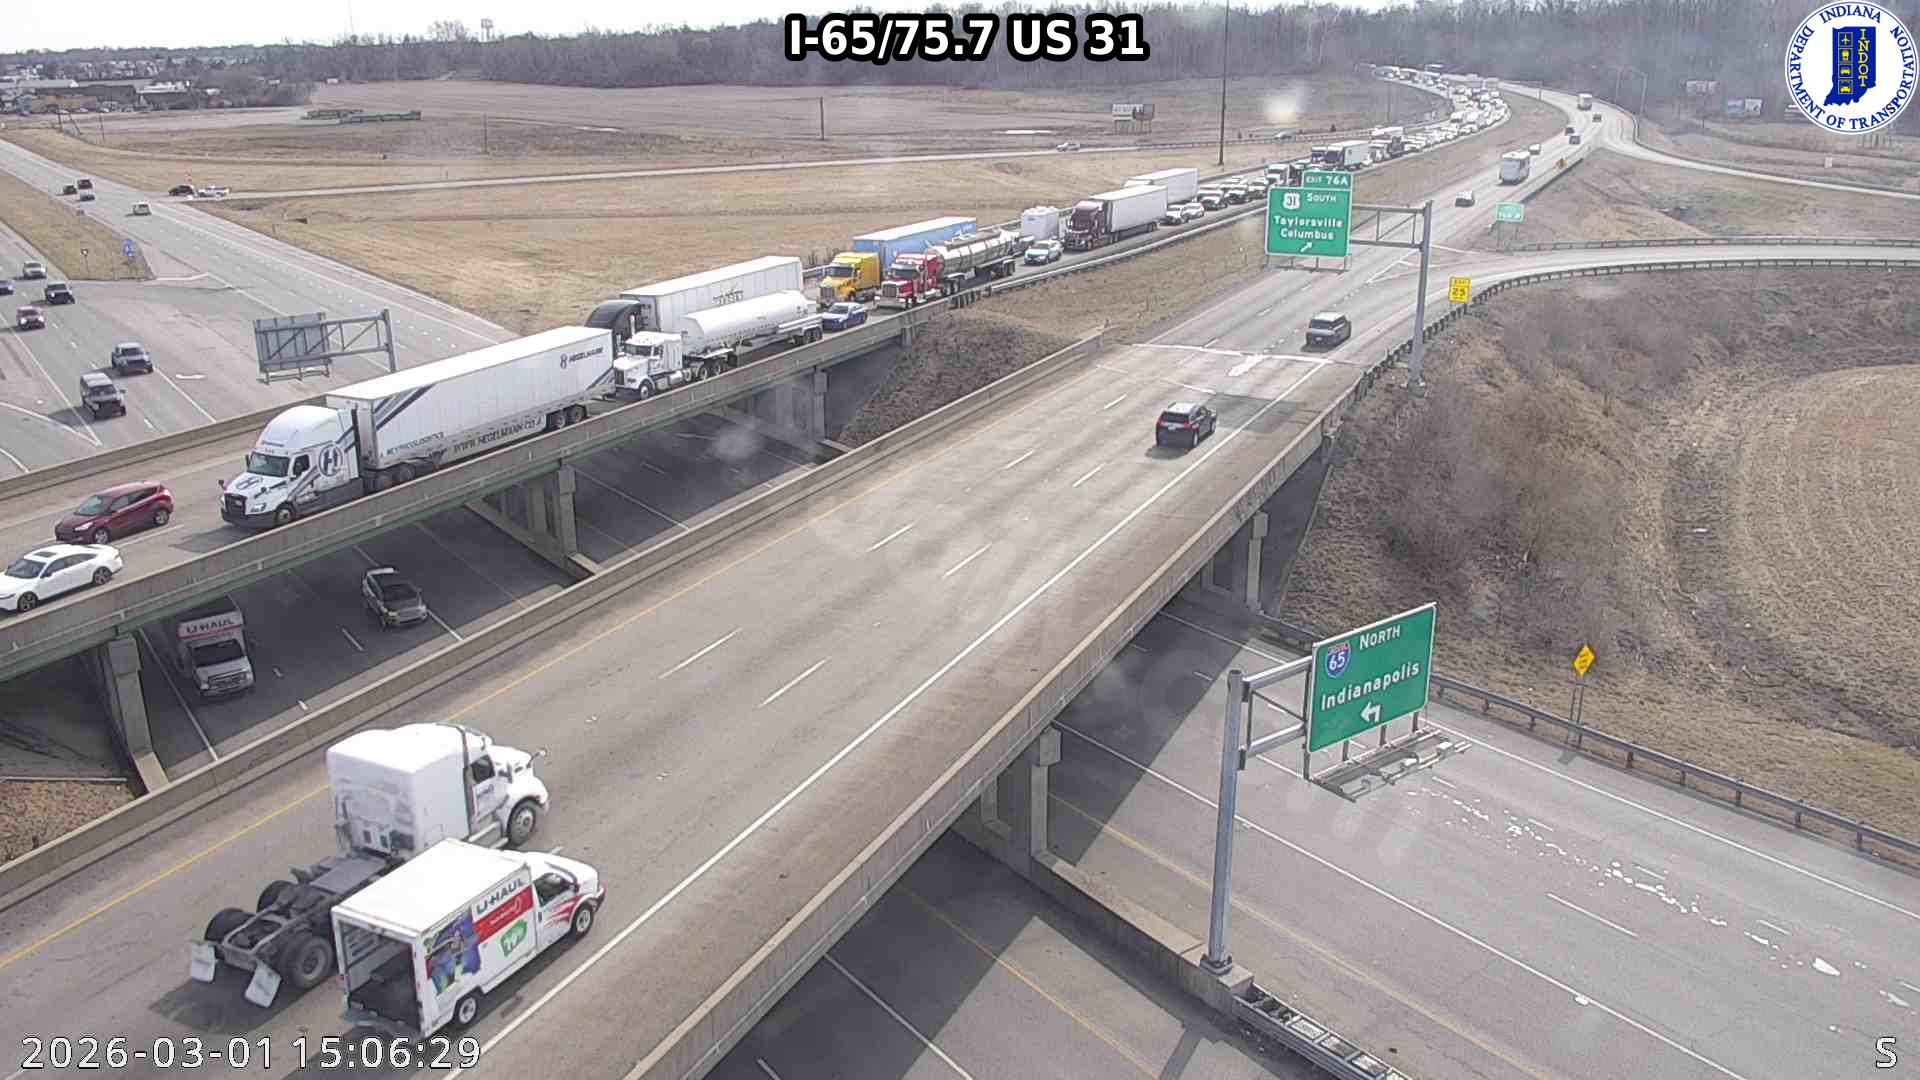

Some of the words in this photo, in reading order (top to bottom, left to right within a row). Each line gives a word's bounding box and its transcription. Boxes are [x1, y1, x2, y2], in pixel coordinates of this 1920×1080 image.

[1327, 175, 1348, 186] 76A
[1306, 192, 1337, 203] SOUTH
[1273, 215, 1344, 228] Taylorsville
[1280, 228, 1335, 240] Columbus
[1359, 624, 1401, 650] NORTH
[1329, 651, 1346, 671] 65
[1320, 661, 1420, 711] Indianapolis
